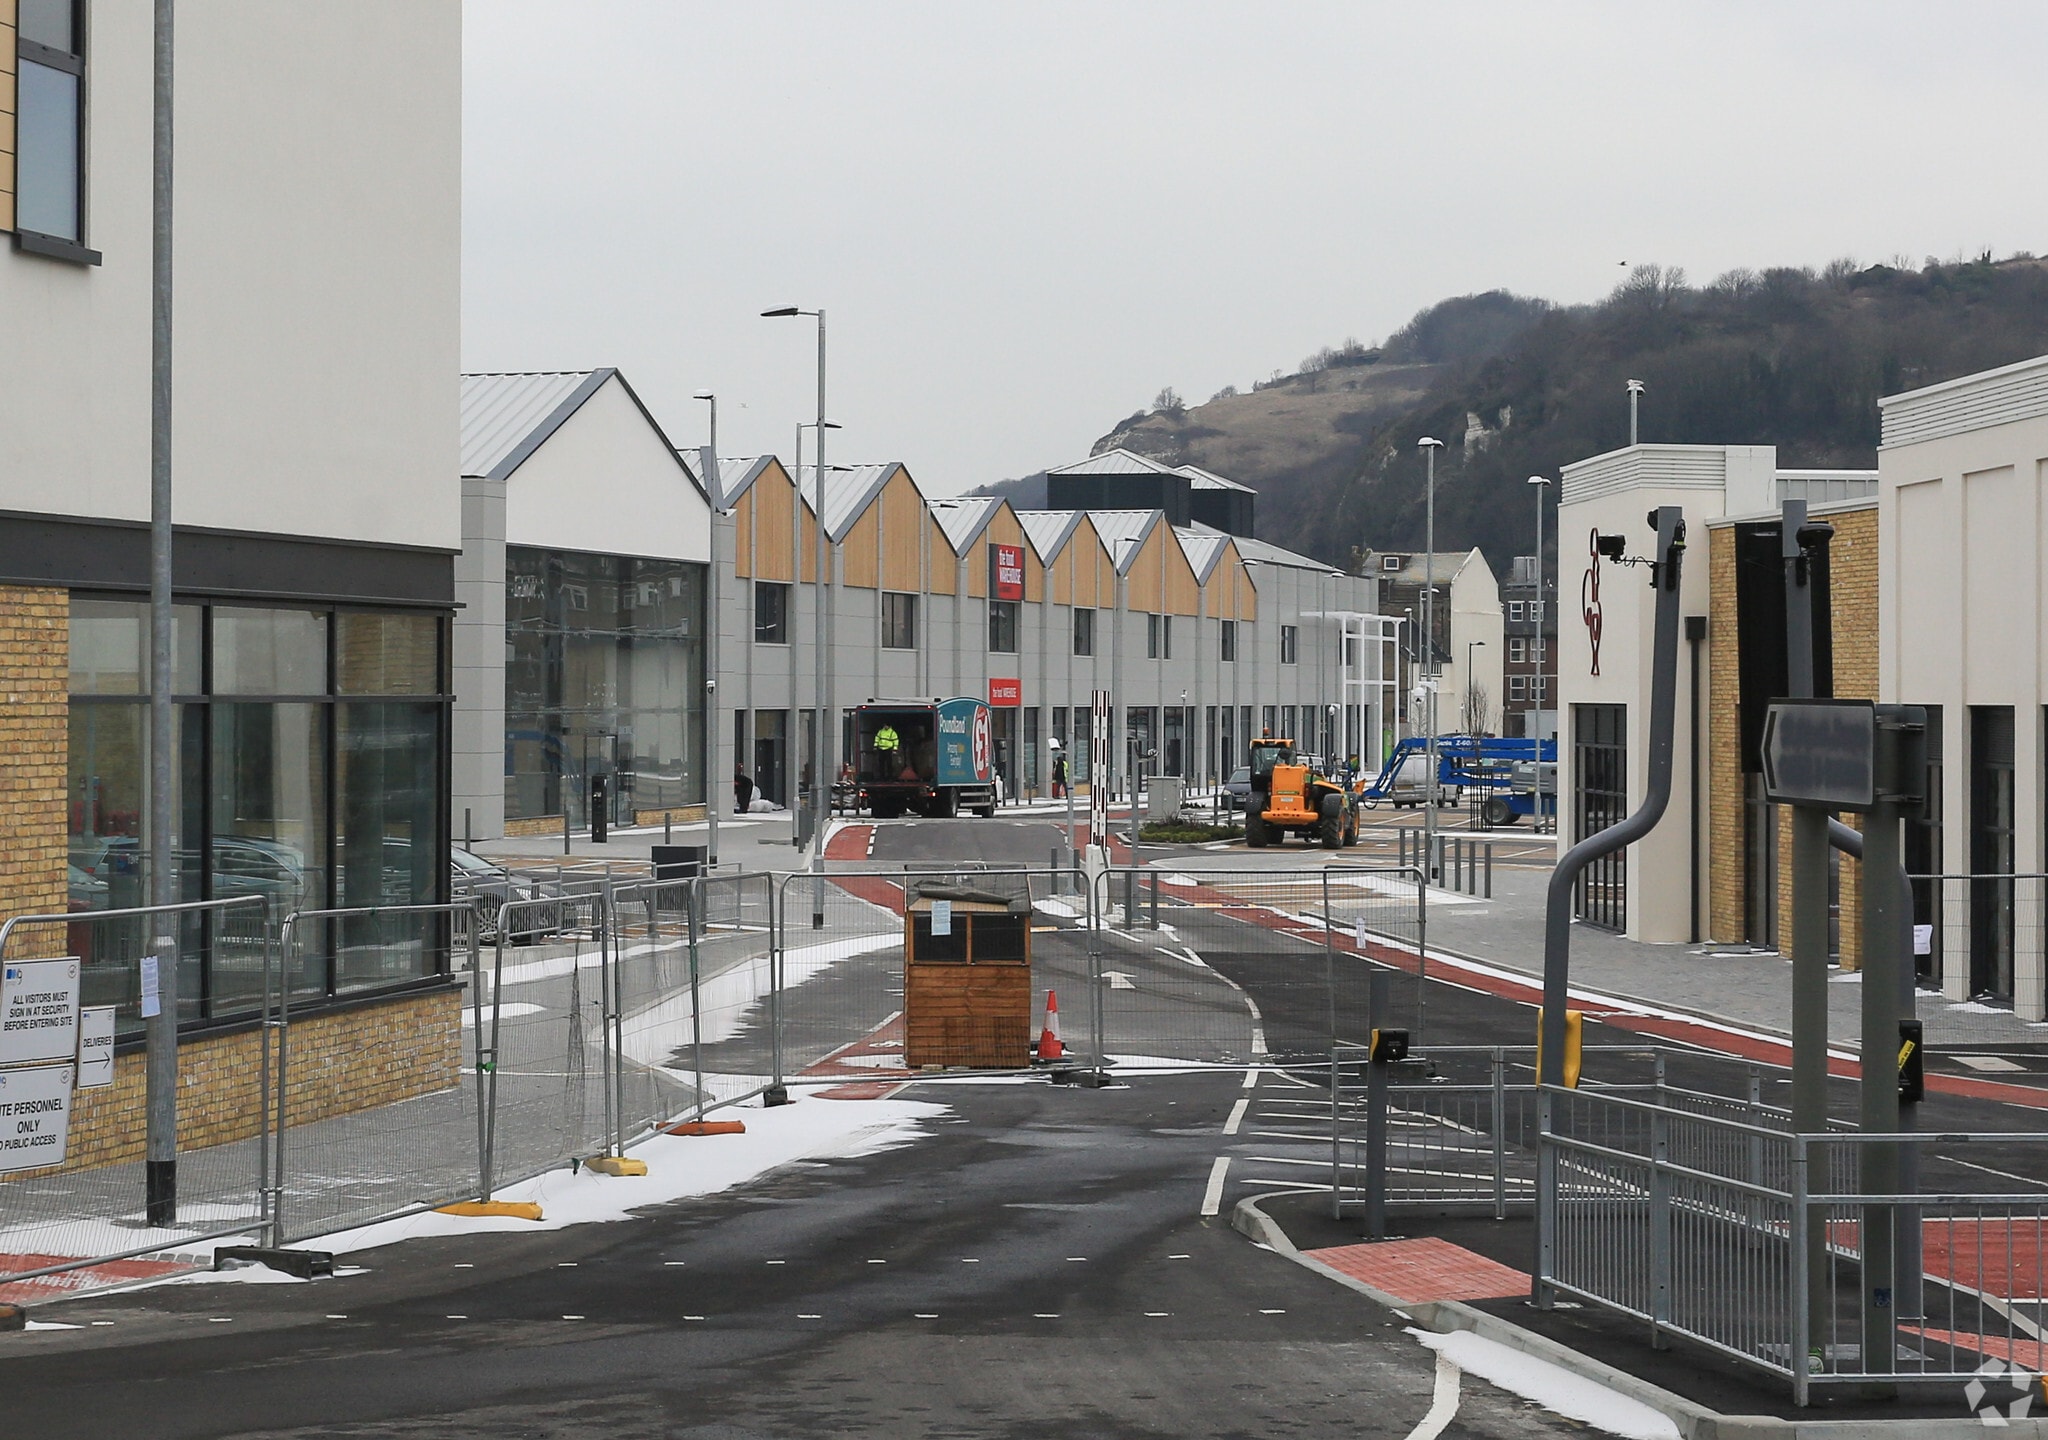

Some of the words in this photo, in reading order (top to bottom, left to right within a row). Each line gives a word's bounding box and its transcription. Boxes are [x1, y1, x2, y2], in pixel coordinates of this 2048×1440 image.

[13, 995, 24, 1005] ALL
[25, 992, 52, 1004] VISITORS
[52, 991, 69, 1003] MUST
[10, 1007, 25, 1018] SIGN
[25, 1006, 33, 1017] IN
[33, 1006, 41, 1016] AT
[41, 1004, 70, 1016] SECURITY
[4, 1020, 29, 1031] BEFORE
[29, 1018, 59, 1030] ENTERING
[60, 1016, 73, 1027] SITE
[83, 1036, 112, 1048] DELIVERIES
[0, 1103, 12, 1117] ITE
[14, 1098, 63, 1116] PERSONNEL
[17, 1119, 41, 1134] ONLY
[4, 1137, 30, 1150] PUBLIC
[30, 1134, 57, 1147] ACCESS
